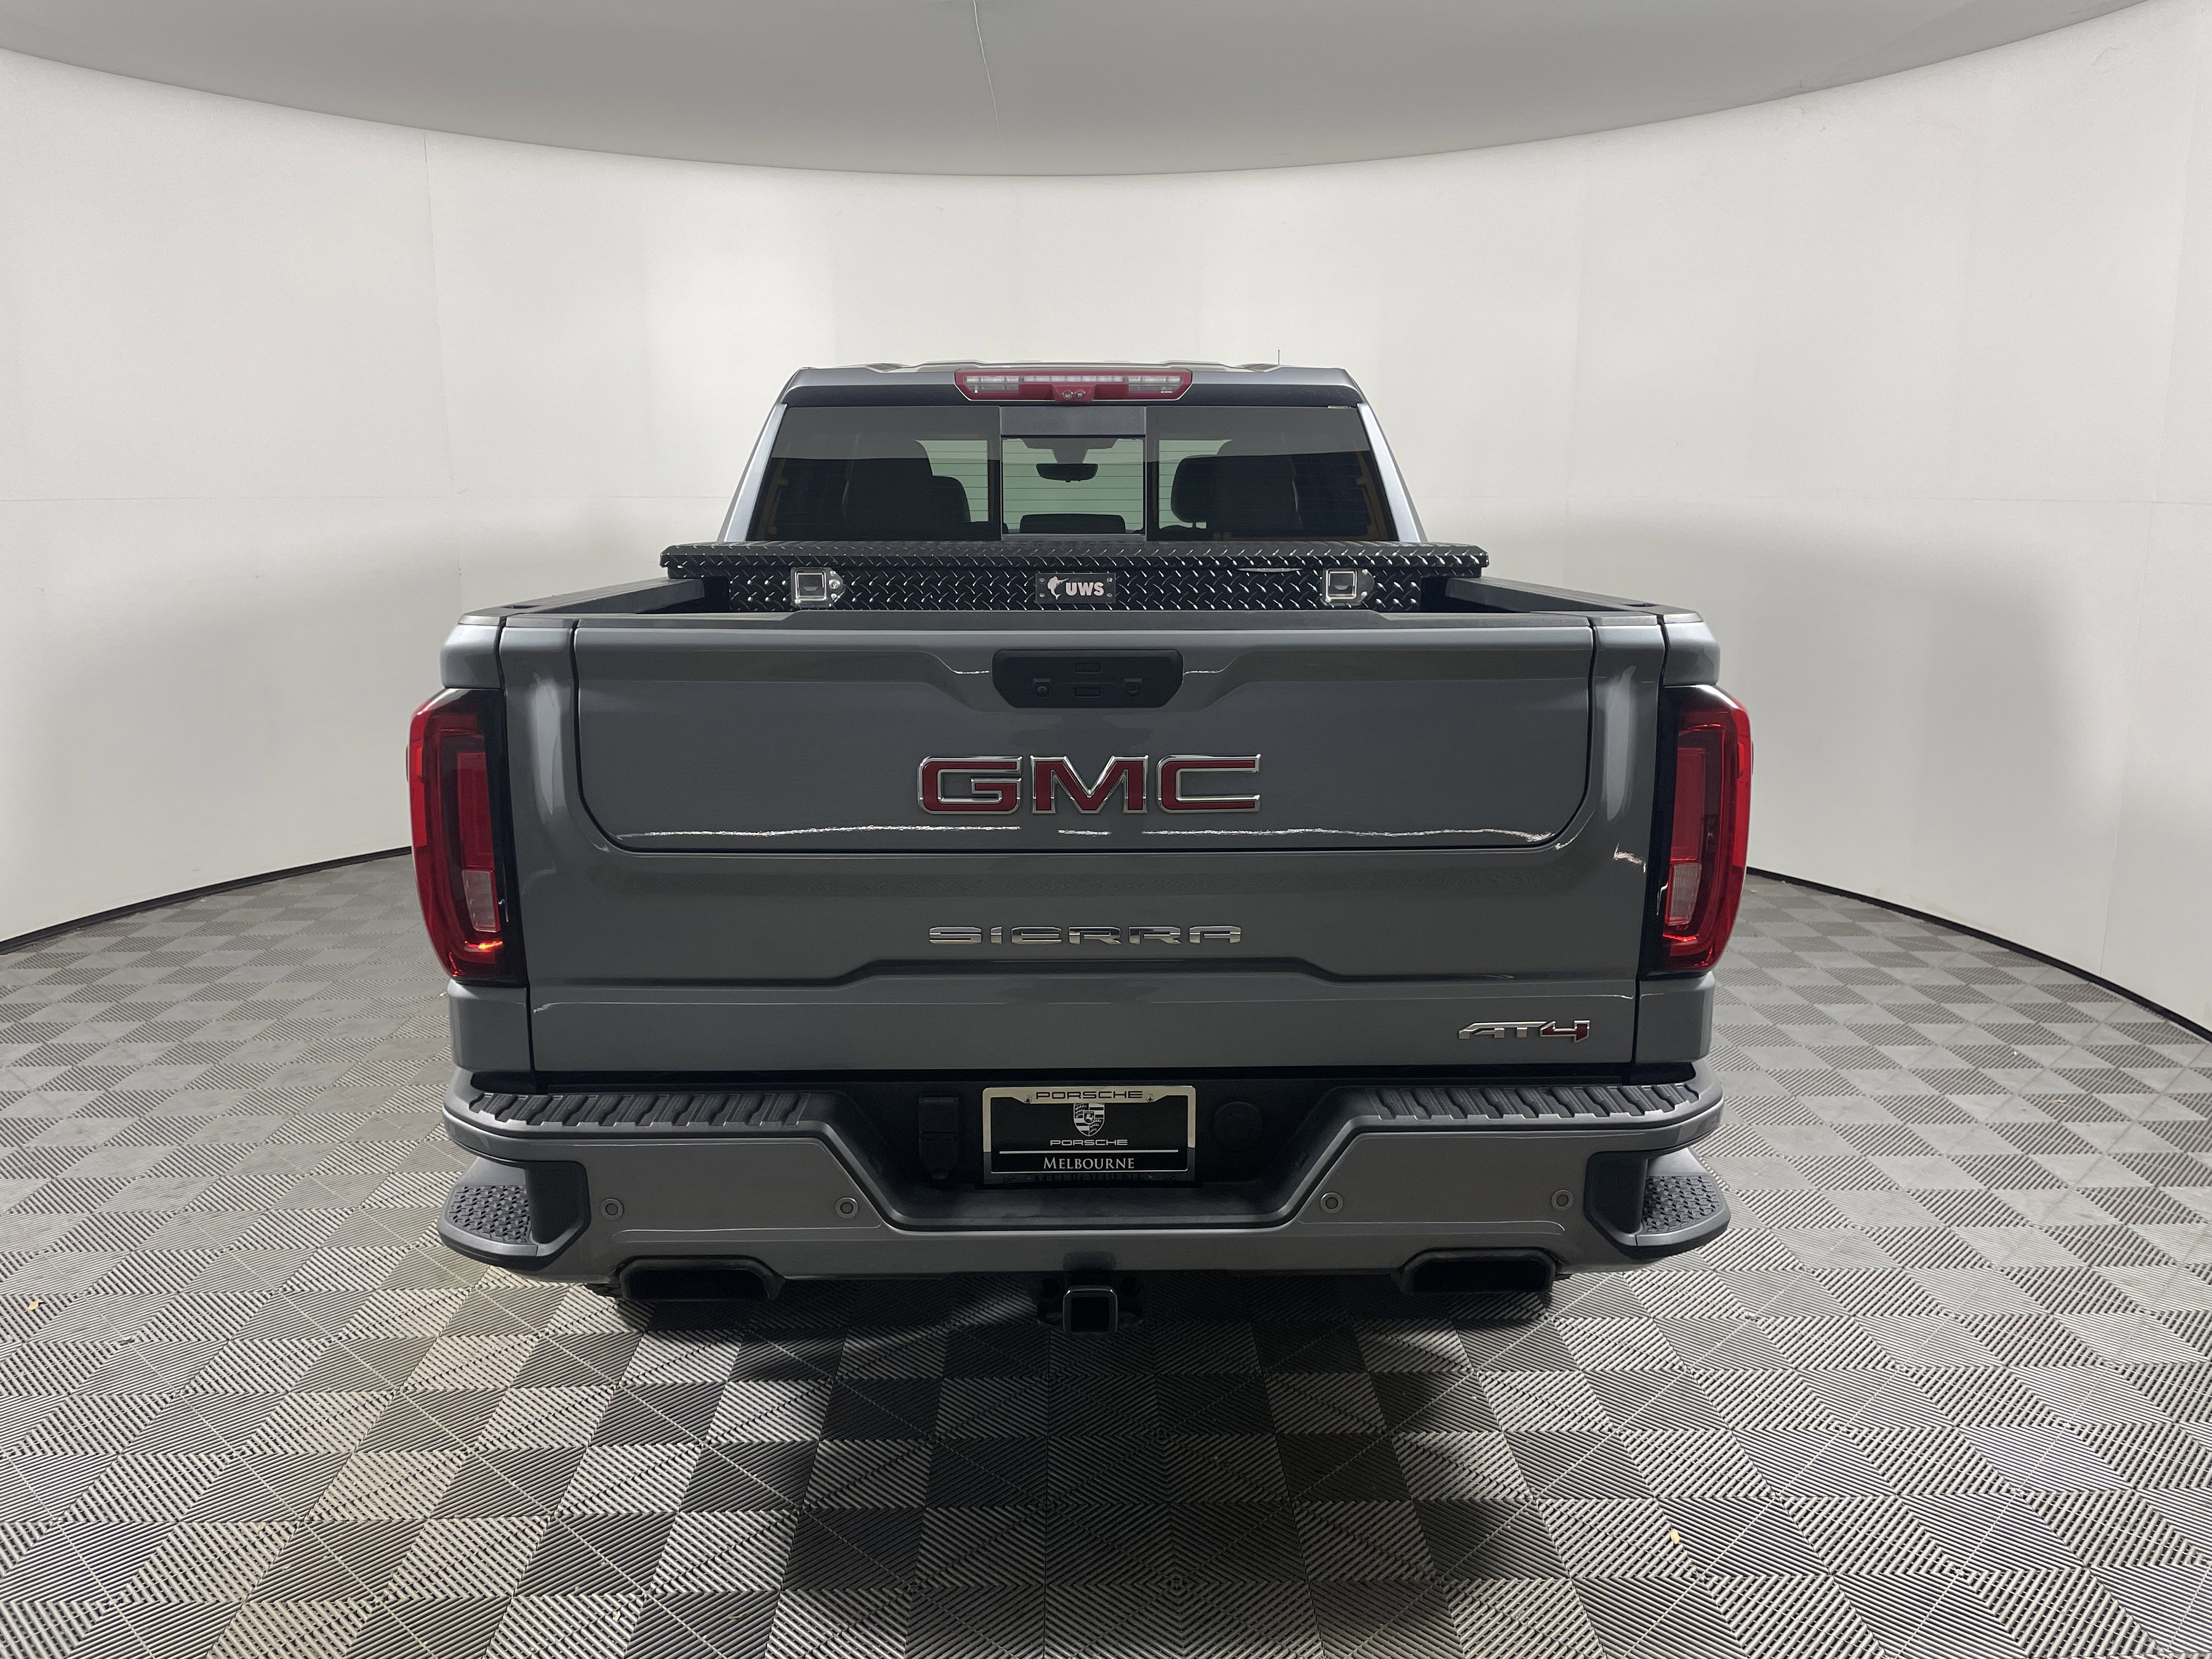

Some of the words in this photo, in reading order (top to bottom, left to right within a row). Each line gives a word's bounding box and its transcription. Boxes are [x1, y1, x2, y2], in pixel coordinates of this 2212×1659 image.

[1065, 582, 1104, 596] UWS
[917, 754, 1261, 815] GMC
[929, 925, 1242, 944] SIERRA
[1458, 1020, 1590, 1043] AT4
[1036, 1091, 1143, 1099] PORSCHE
[1043, 1156, 1135, 1169] MELBOURNE
